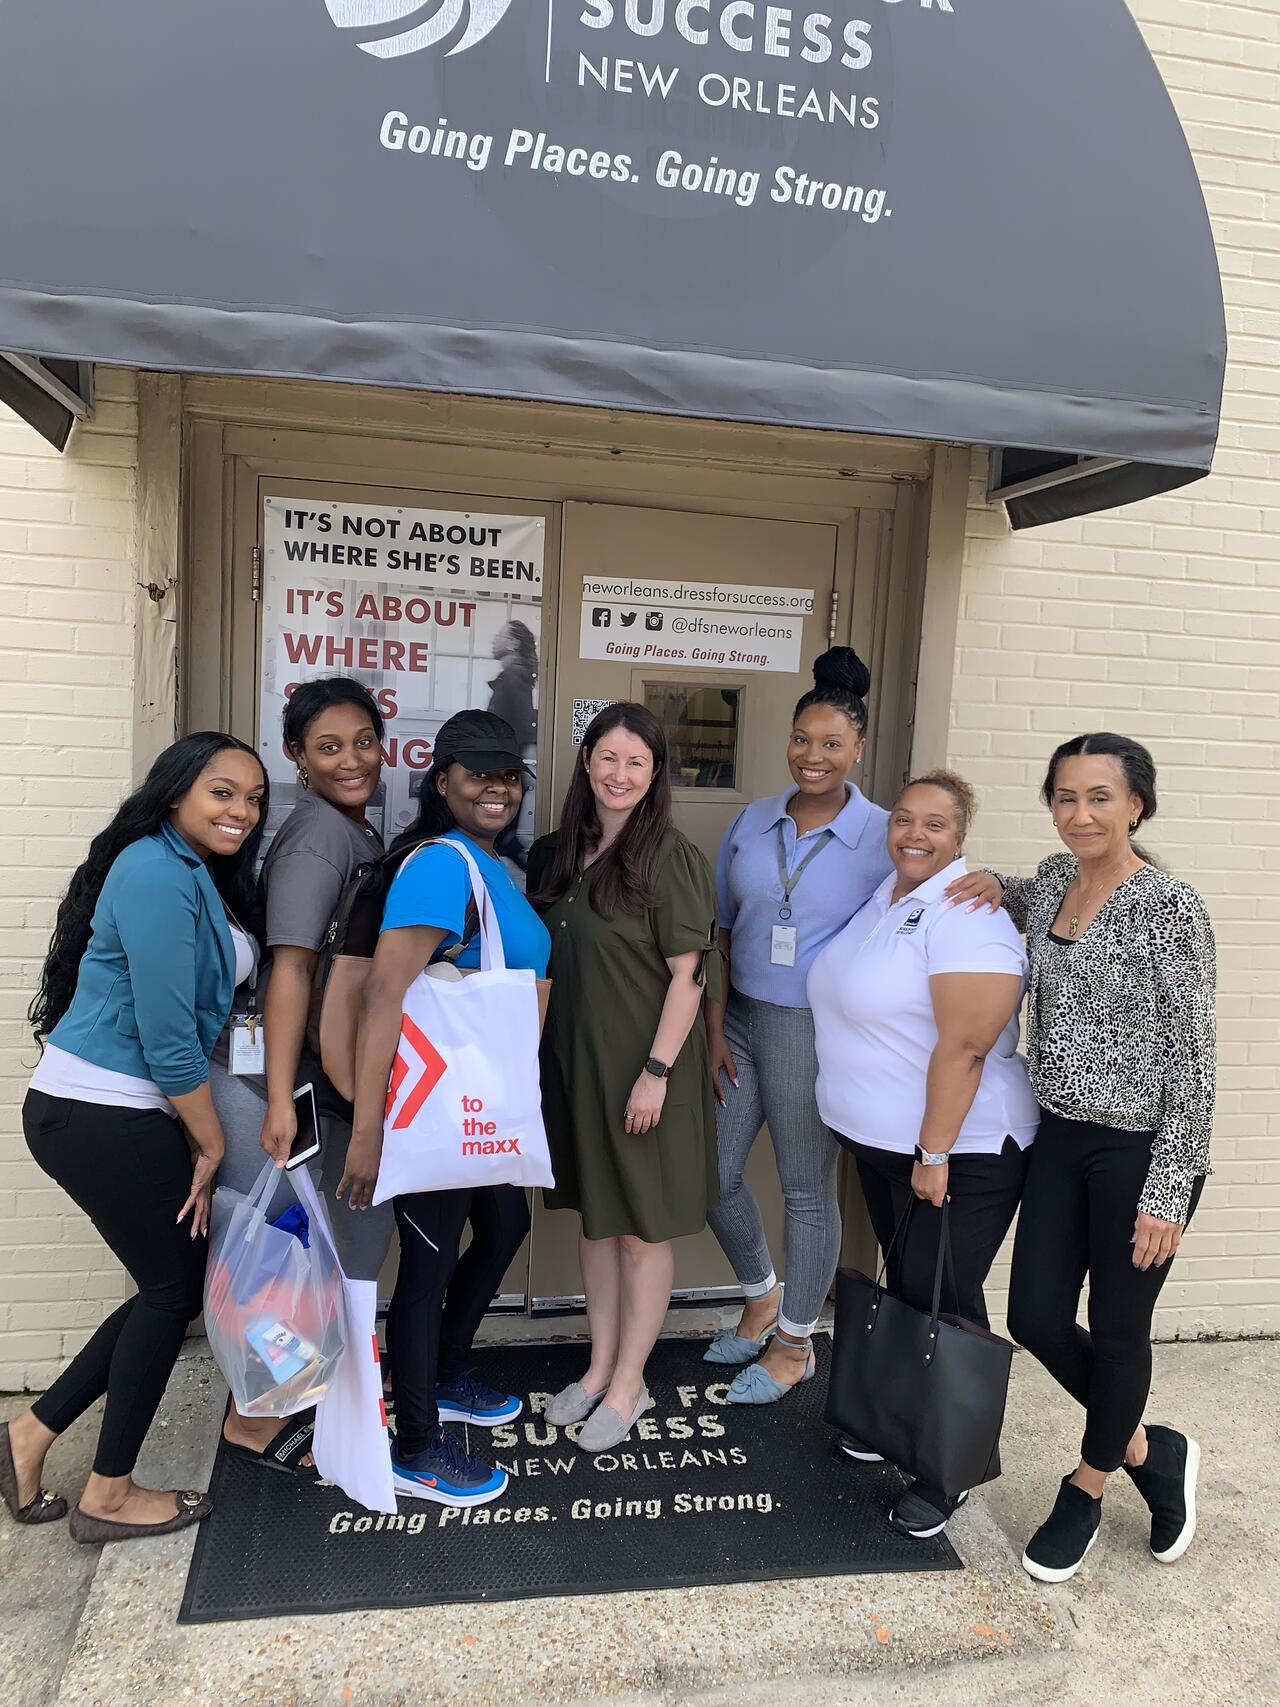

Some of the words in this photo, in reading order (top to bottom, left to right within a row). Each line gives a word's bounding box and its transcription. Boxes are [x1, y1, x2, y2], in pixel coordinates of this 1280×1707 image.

[579, 0, 873, 70] SUCCESS
[578, 51, 680, 100] NEW
[698, 73, 880, 130] ORLEANS
[379, 110, 494, 172] Going
[503, 128, 640, 184] Places.
[655, 150, 761, 207] Going
[770, 166, 894, 224] Strong.
[284, 509, 332, 533] IT'S
[342, 515, 401, 540] NOT
[408, 522, 502, 547] ABOUT
[283, 541, 378, 568] WHERE
[386, 549, 460, 575] SHE'S
[469, 557, 541, 583] BEEN.
[285, 588, 344, 618] IT'S
[355, 594, 477, 628] ABOUT
[582, 580, 814, 612] neworleans.dressforsuccess.org
[671, 616, 793, 640] @dfsneworleans
[283, 632, 429, 673] WHERE
[605, 641, 641, 658] Going
[643, 644, 688, 660] Places.
[692, 647, 726, 664] Going
[728, 650, 771, 667] Strong.
[461, 1095, 483, 1113] to
[462, 1117, 497, 1136] the
[462, 1138, 522, 1156] maxx
[676, 1382, 733, 1409] FO
[279, 1431, 305, 1458] MICHAEL
[490, 1413, 726, 1449] SUCESS
[495, 1455, 577, 1478] NEW
[592, 1447, 747, 1473] ORLEANS
[328, 1511, 427, 1535] Going
[437, 1505, 558, 1528] Places.
[571, 1497, 662, 1520] Going
[673, 1492, 782, 1514] Strong.
